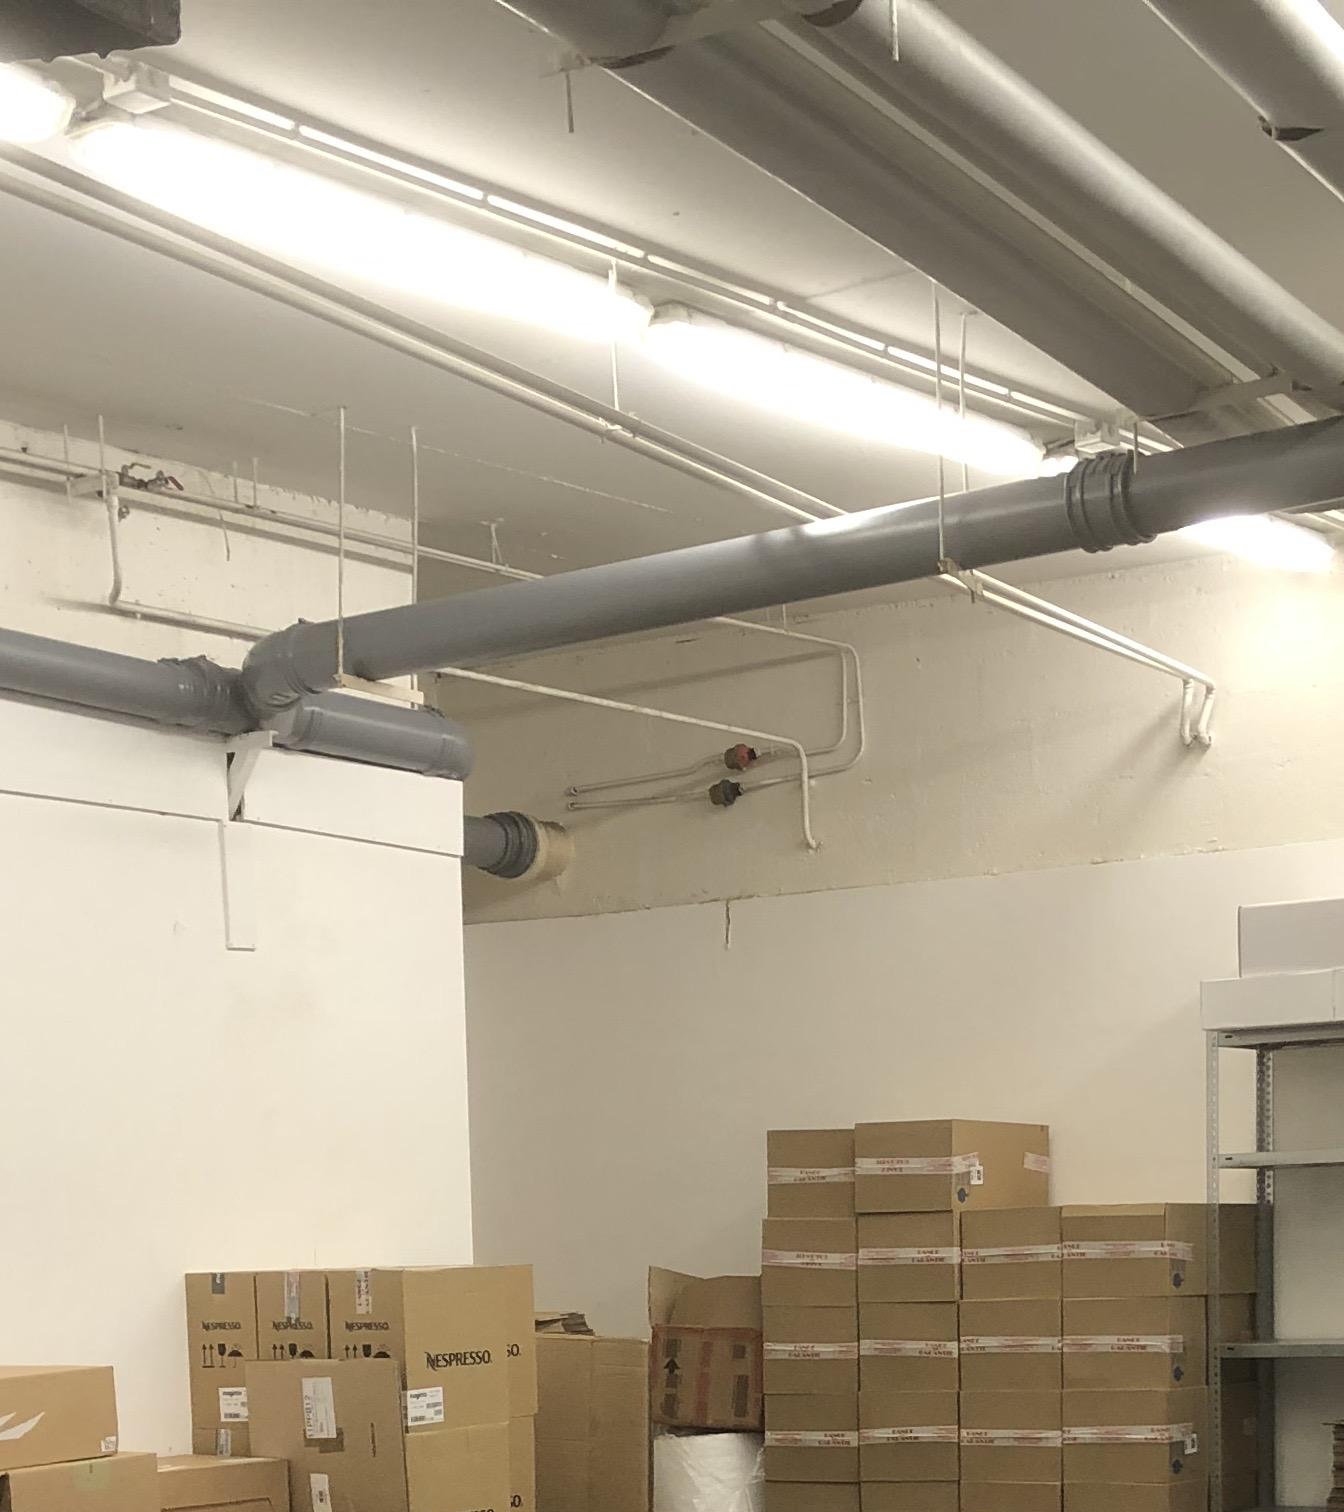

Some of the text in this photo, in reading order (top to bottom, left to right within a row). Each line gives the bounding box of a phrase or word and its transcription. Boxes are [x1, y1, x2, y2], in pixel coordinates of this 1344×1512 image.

[202, 1321, 242, 1331] NESPRESSO
[345, 1321, 390, 1332] NESPRESSO
[424, 1349, 492, 1372] NESPRESSO
